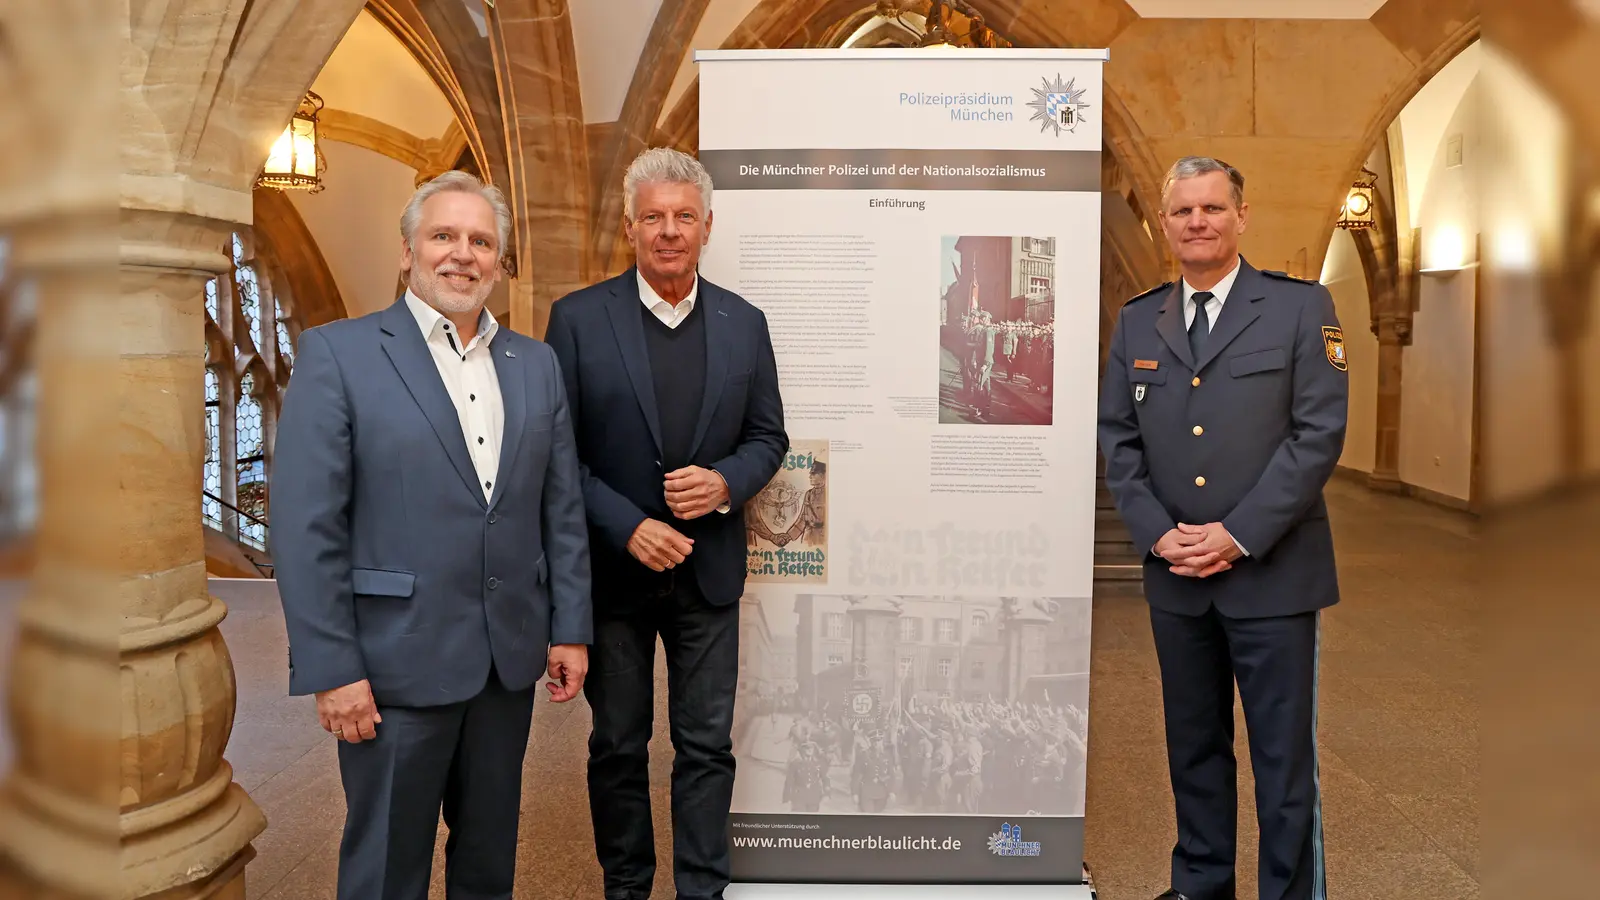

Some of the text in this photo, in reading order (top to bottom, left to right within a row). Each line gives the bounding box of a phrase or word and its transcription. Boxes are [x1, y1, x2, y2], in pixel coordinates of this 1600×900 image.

[899, 92, 1013, 107] Polizeipräsidium
[950, 107, 1013, 122] München
[739, 163, 1046, 178] Die Münchner Polizei und der Nationalsozialismus
[869, 198, 926, 211] Einführung
[733, 834, 962, 851] www.muenchnerblaulicht.de
